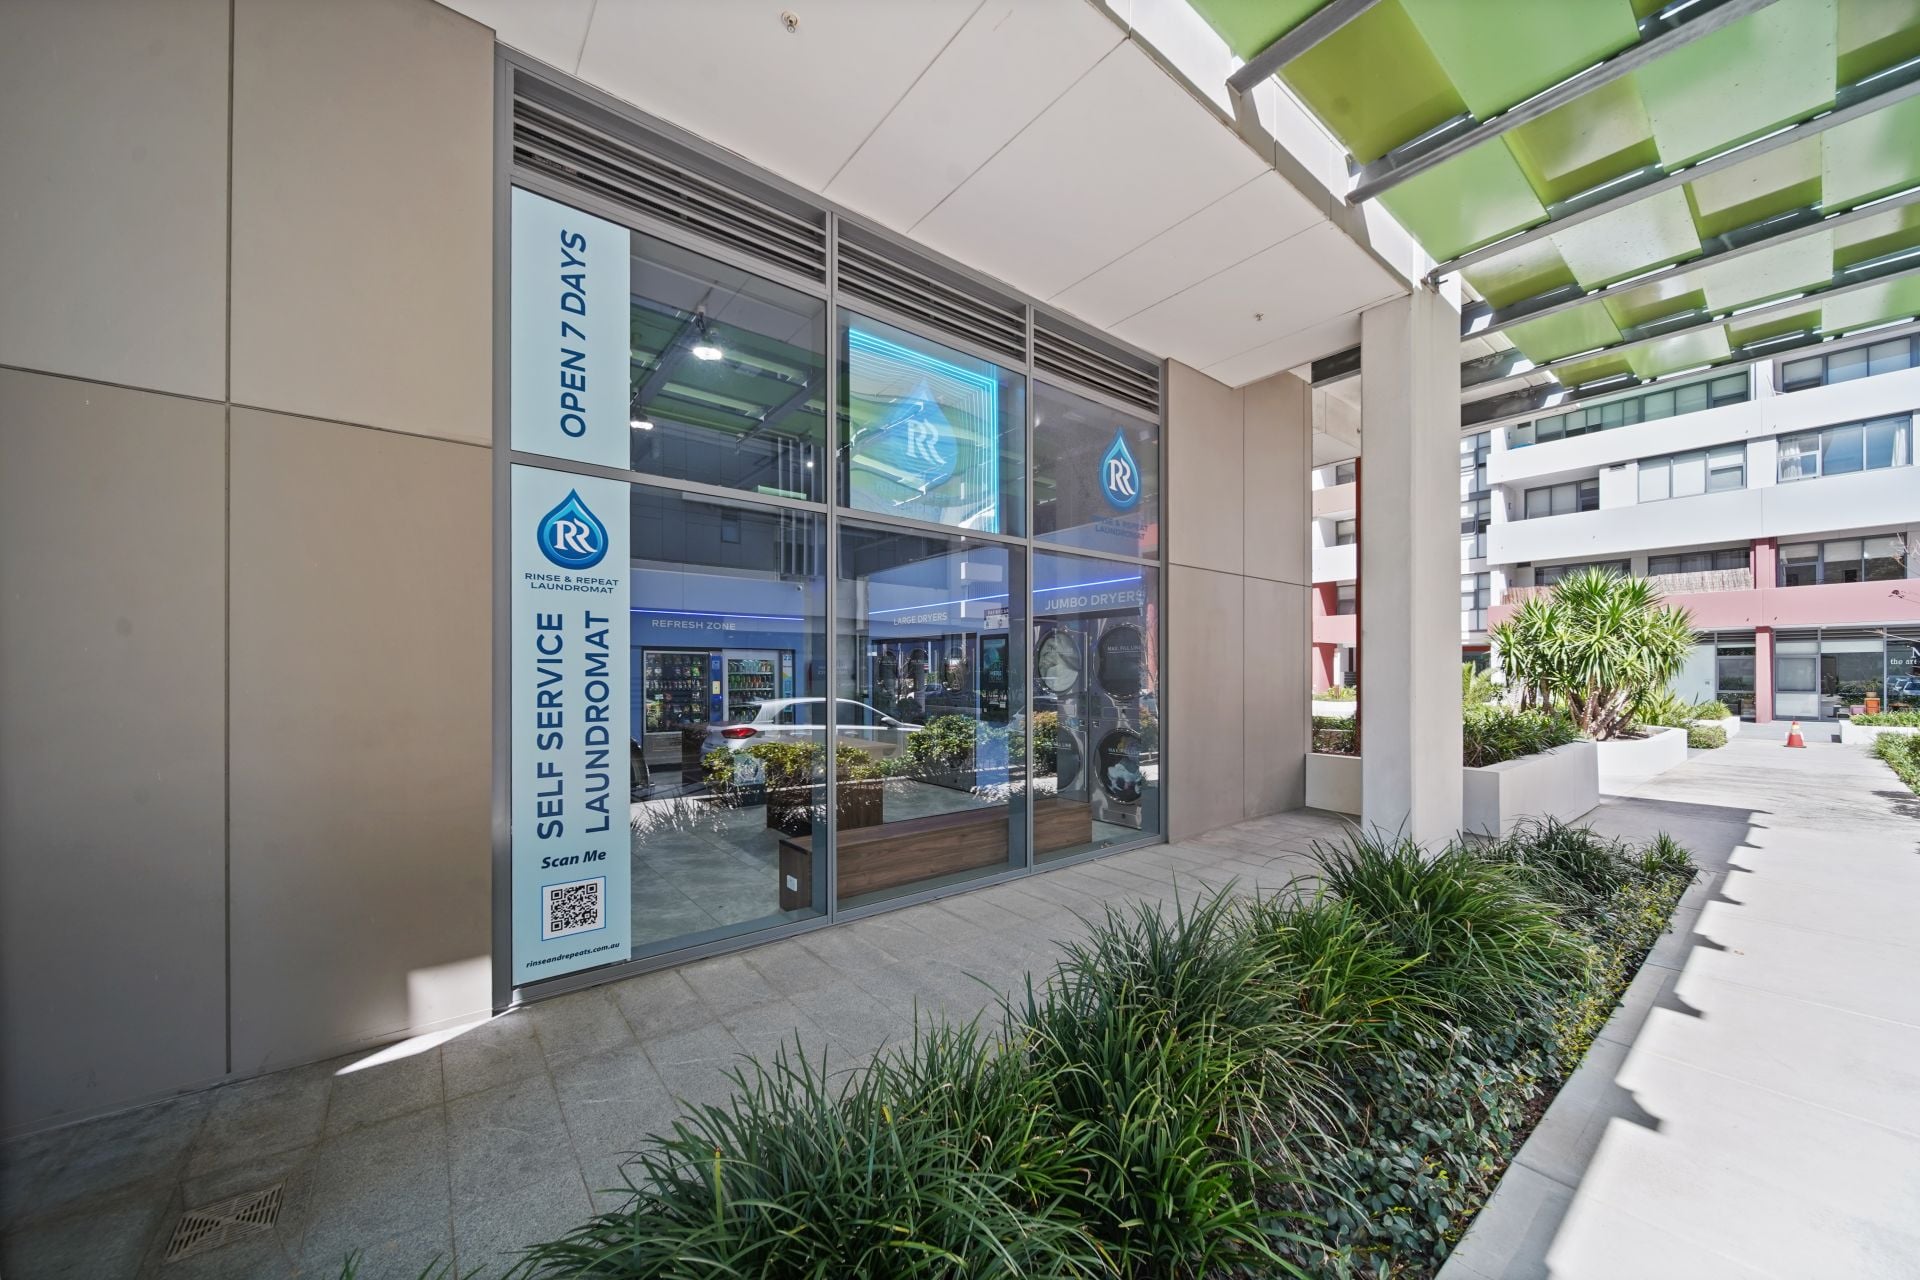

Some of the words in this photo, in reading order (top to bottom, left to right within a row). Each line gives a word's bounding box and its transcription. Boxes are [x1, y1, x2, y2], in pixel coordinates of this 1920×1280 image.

[560, 229, 587, 317] DAYS
[561, 321, 586, 341] 7
[560, 348, 586, 438] OPEN
[1109, 457, 1136, 496] RR
[553, 517, 598, 554] RR
[525, 572, 561, 582] RINSE
[564, 575, 572, 583] &
[576, 576, 619, 586] REPEAT
[531, 582, 614, 594] LAUNDROMAT
[1045, 596, 1088, 611] JUMBO
[1090, 590, 1143, 606] DRYERS
[651, 619, 703, 630] REFRESH
[706, 621, 736, 631] ZONE
[893, 615, 916, 626] LARGE
[916, 612, 948, 624] DRYERS
[536, 613, 563, 751] SERVICE
[585, 610, 610, 834] LAUNDROMAT
[536, 762, 564, 840] SELF
[541, 855, 580, 870] Scan
[583, 850, 607, 863] Me
[525, 942, 620, 969] rinseandrepeats.com.au
